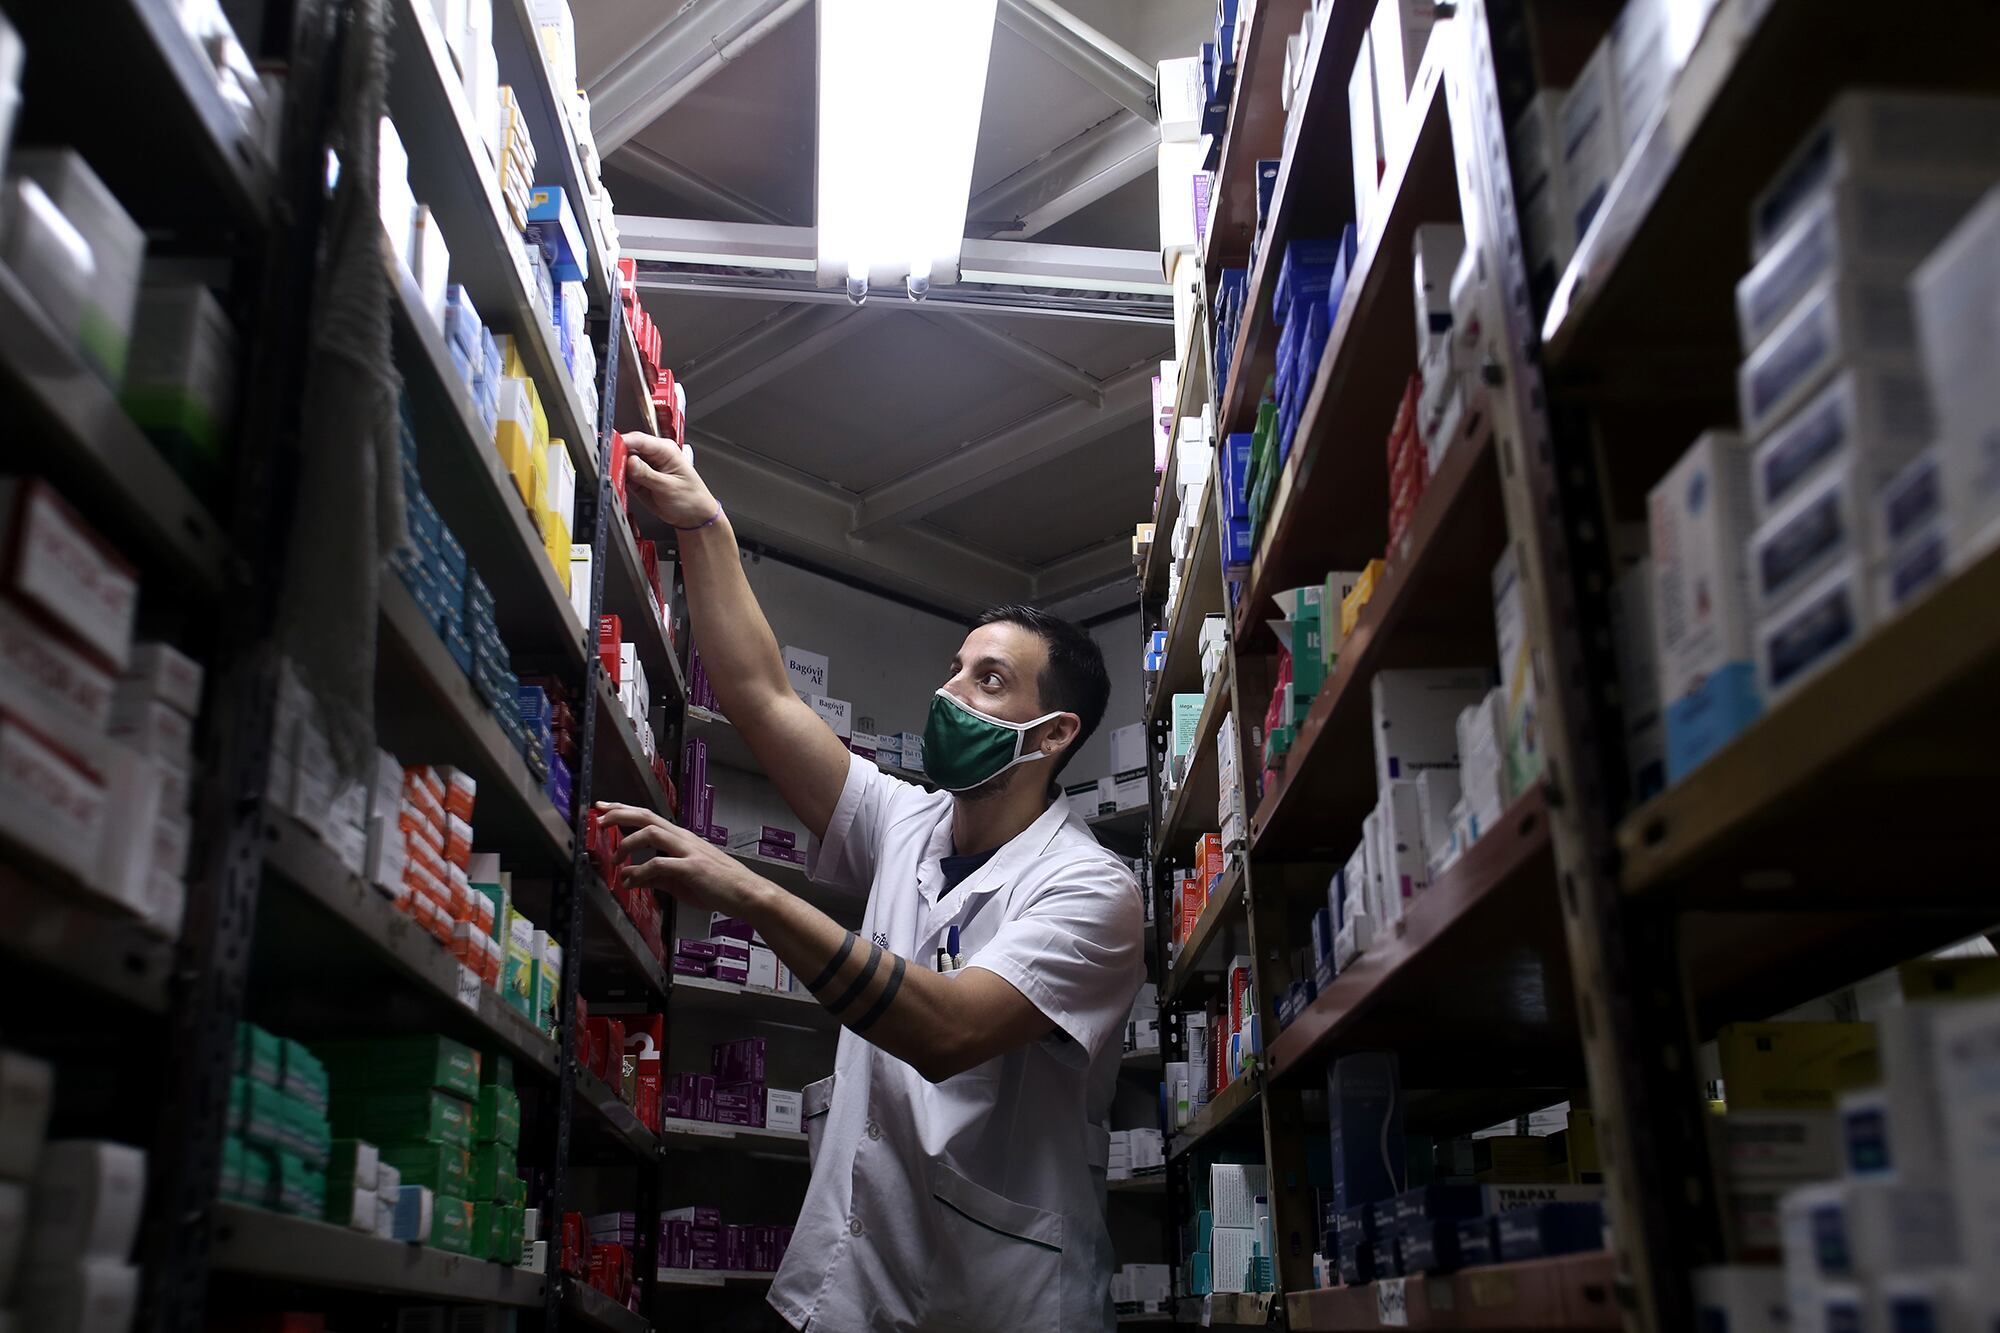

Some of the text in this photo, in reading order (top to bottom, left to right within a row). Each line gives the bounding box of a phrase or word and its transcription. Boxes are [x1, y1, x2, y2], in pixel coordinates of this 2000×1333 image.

[790, 660, 823, 677] Bagóvit
[811, 675, 823, 685] AE
[819, 699, 844, 712] Bagóvit
[1499, 1189, 1556, 1201] TRAPAX
